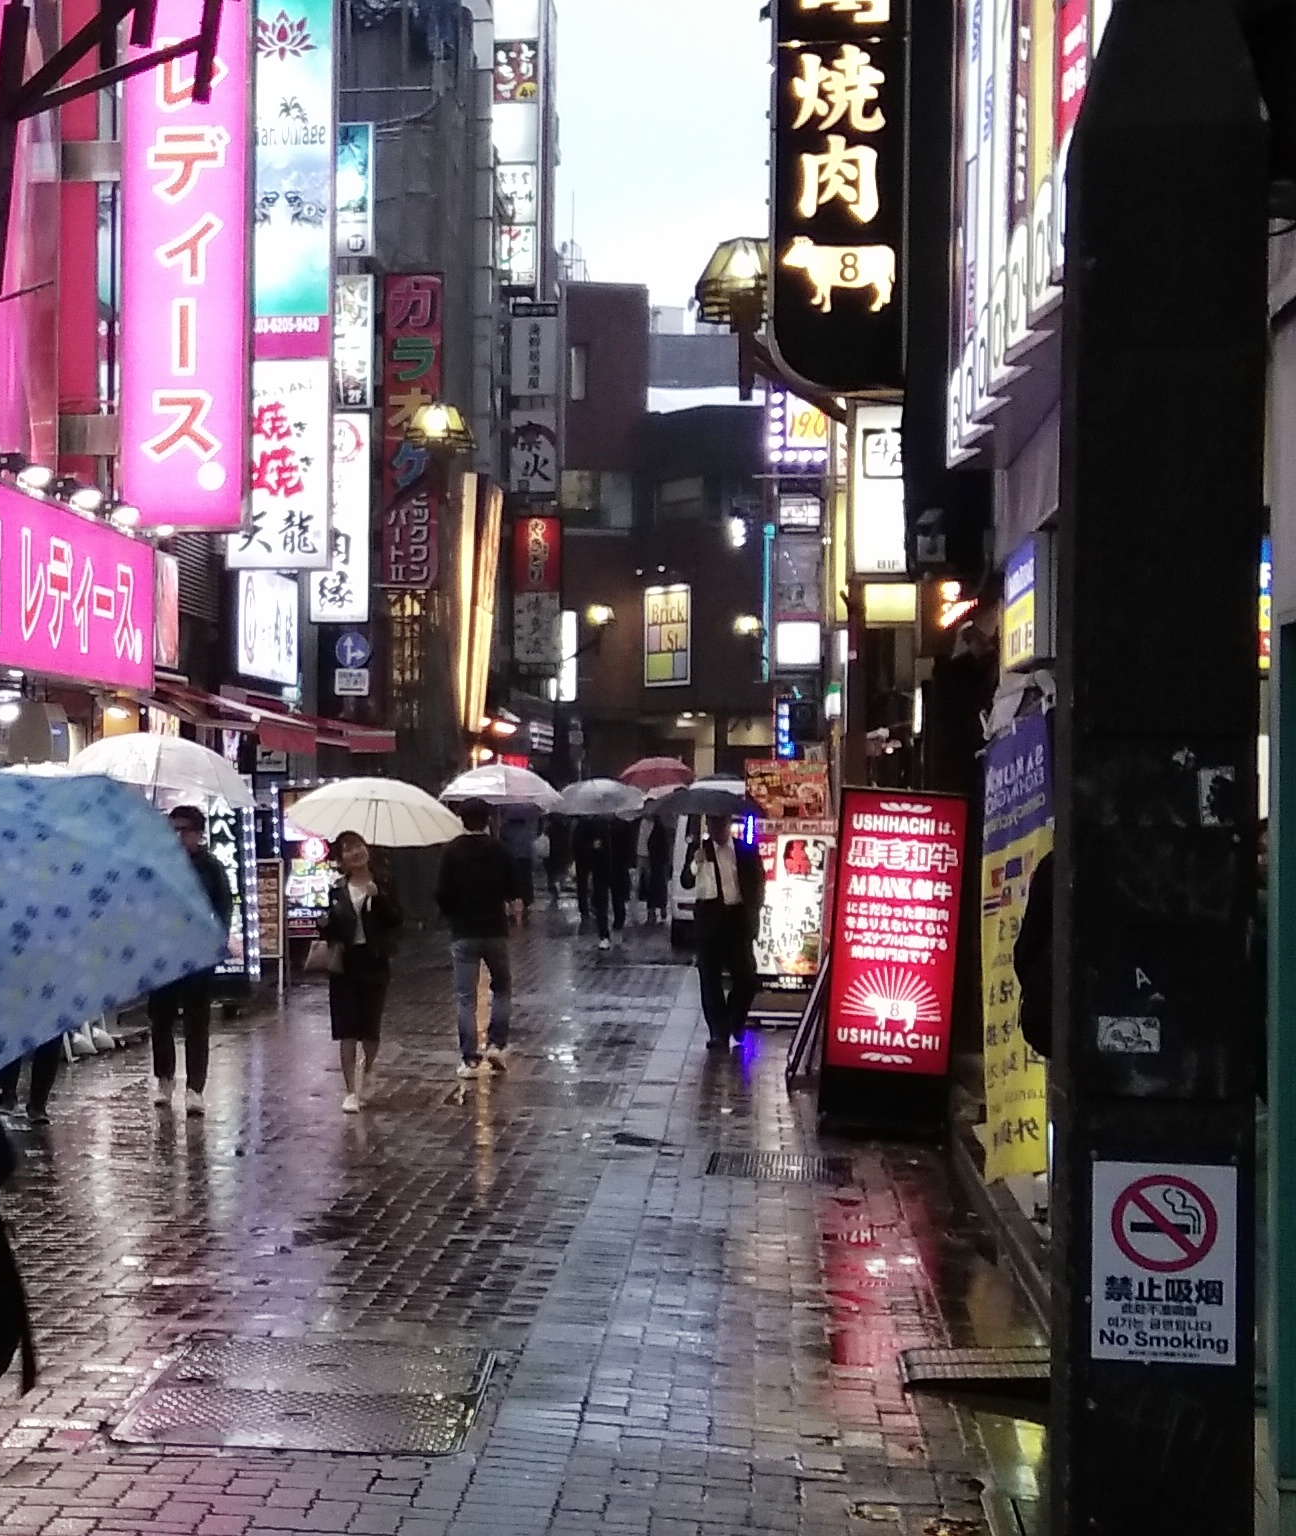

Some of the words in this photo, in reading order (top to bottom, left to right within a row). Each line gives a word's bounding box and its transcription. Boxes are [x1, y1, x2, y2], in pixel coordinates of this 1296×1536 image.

[791, 43, 887, 224] 焼肉
[838, 252, 860, 283] 8
[650, 603, 685, 624] Brick
[852, 813, 936, 836] USHIHACHI
[848, 835, 958, 874] 黒毛和牛
[836, 1027, 941, 1051] USHIHACHI
[1099, 1329, 1129, 1347] No
[1135, 1330, 1229, 1355] Smoking
